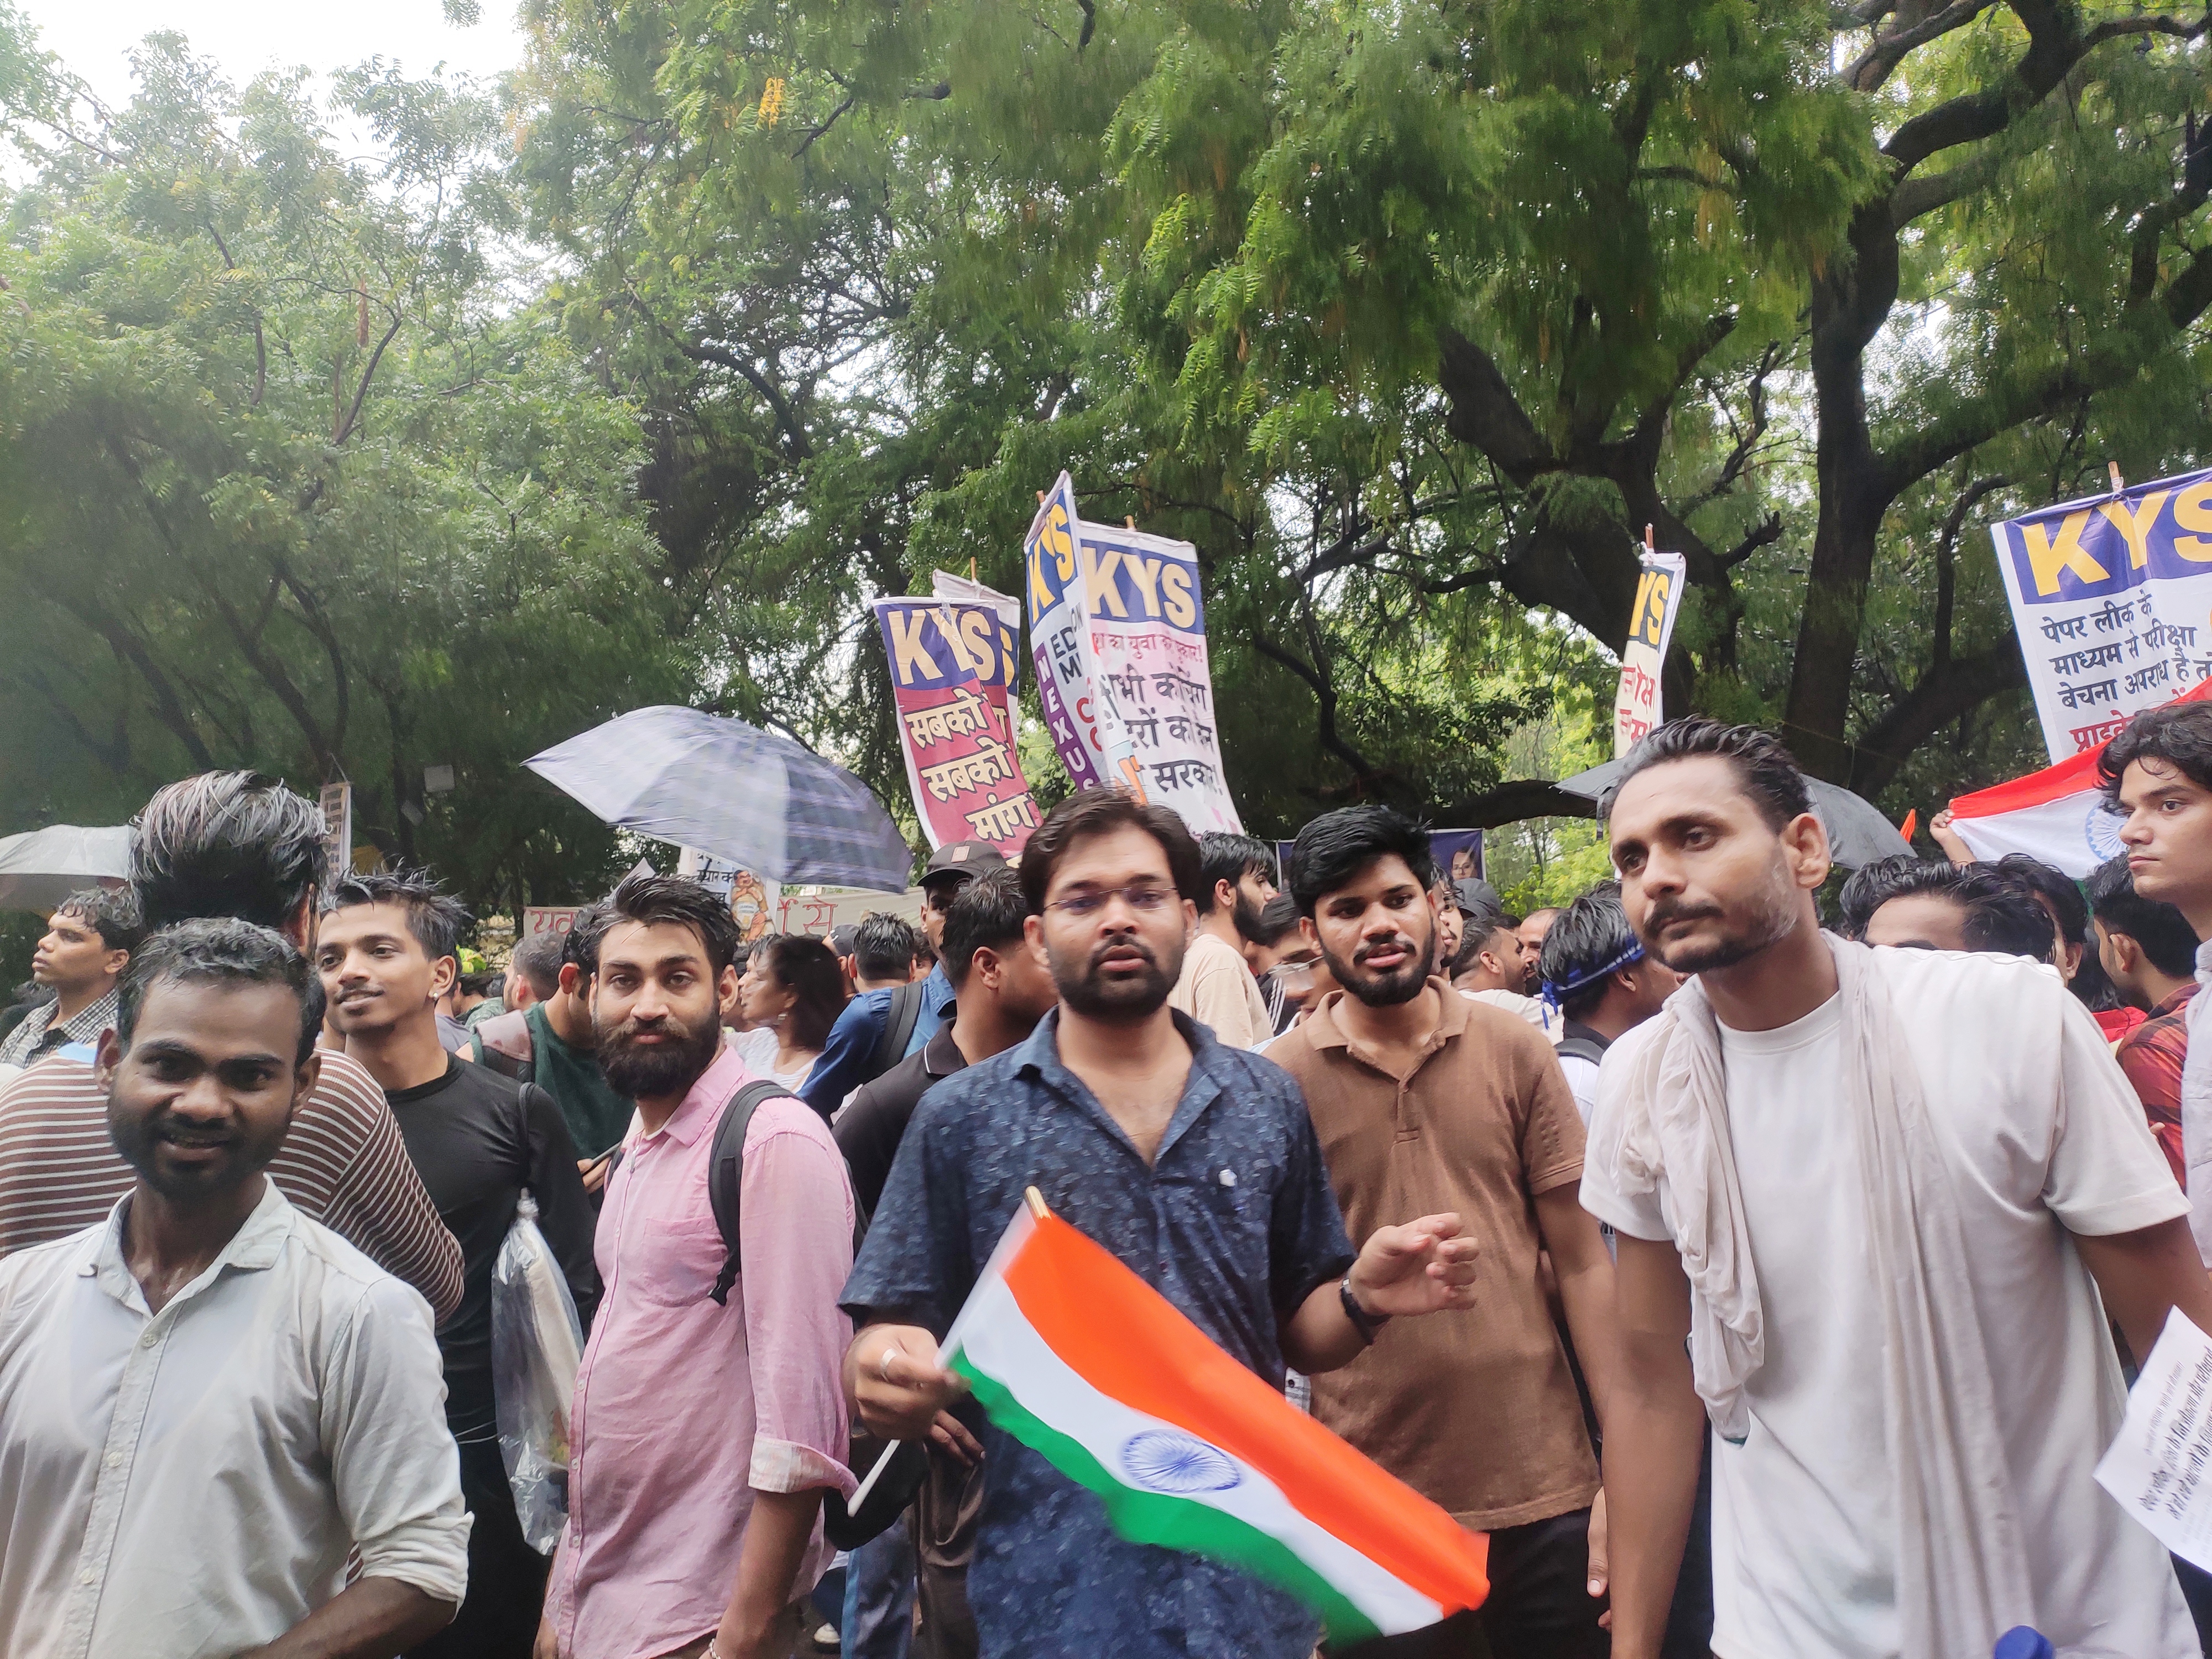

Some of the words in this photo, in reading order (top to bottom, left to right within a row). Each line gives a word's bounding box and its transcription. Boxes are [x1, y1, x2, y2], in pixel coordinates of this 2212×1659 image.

[1081, 546, 1196, 628] KYS
[2039, 617, 2087, 643] पेपर
[2089, 601, 2135, 633] लीक
[2137, 589, 2152, 615] के
[887, 608, 995, 685] KYS
[2048, 643, 2123, 675] माध्यम
[2142, 618, 2198, 650] परीक्षा
[2057, 682, 2118, 709] बेचना
[2125, 659, 2169, 694] अपराध
[2171, 647, 2190, 681] है
[904, 686, 989, 749] सबको
[920, 735, 1015, 803] सबको
[963, 792, 1037, 842] मांग
